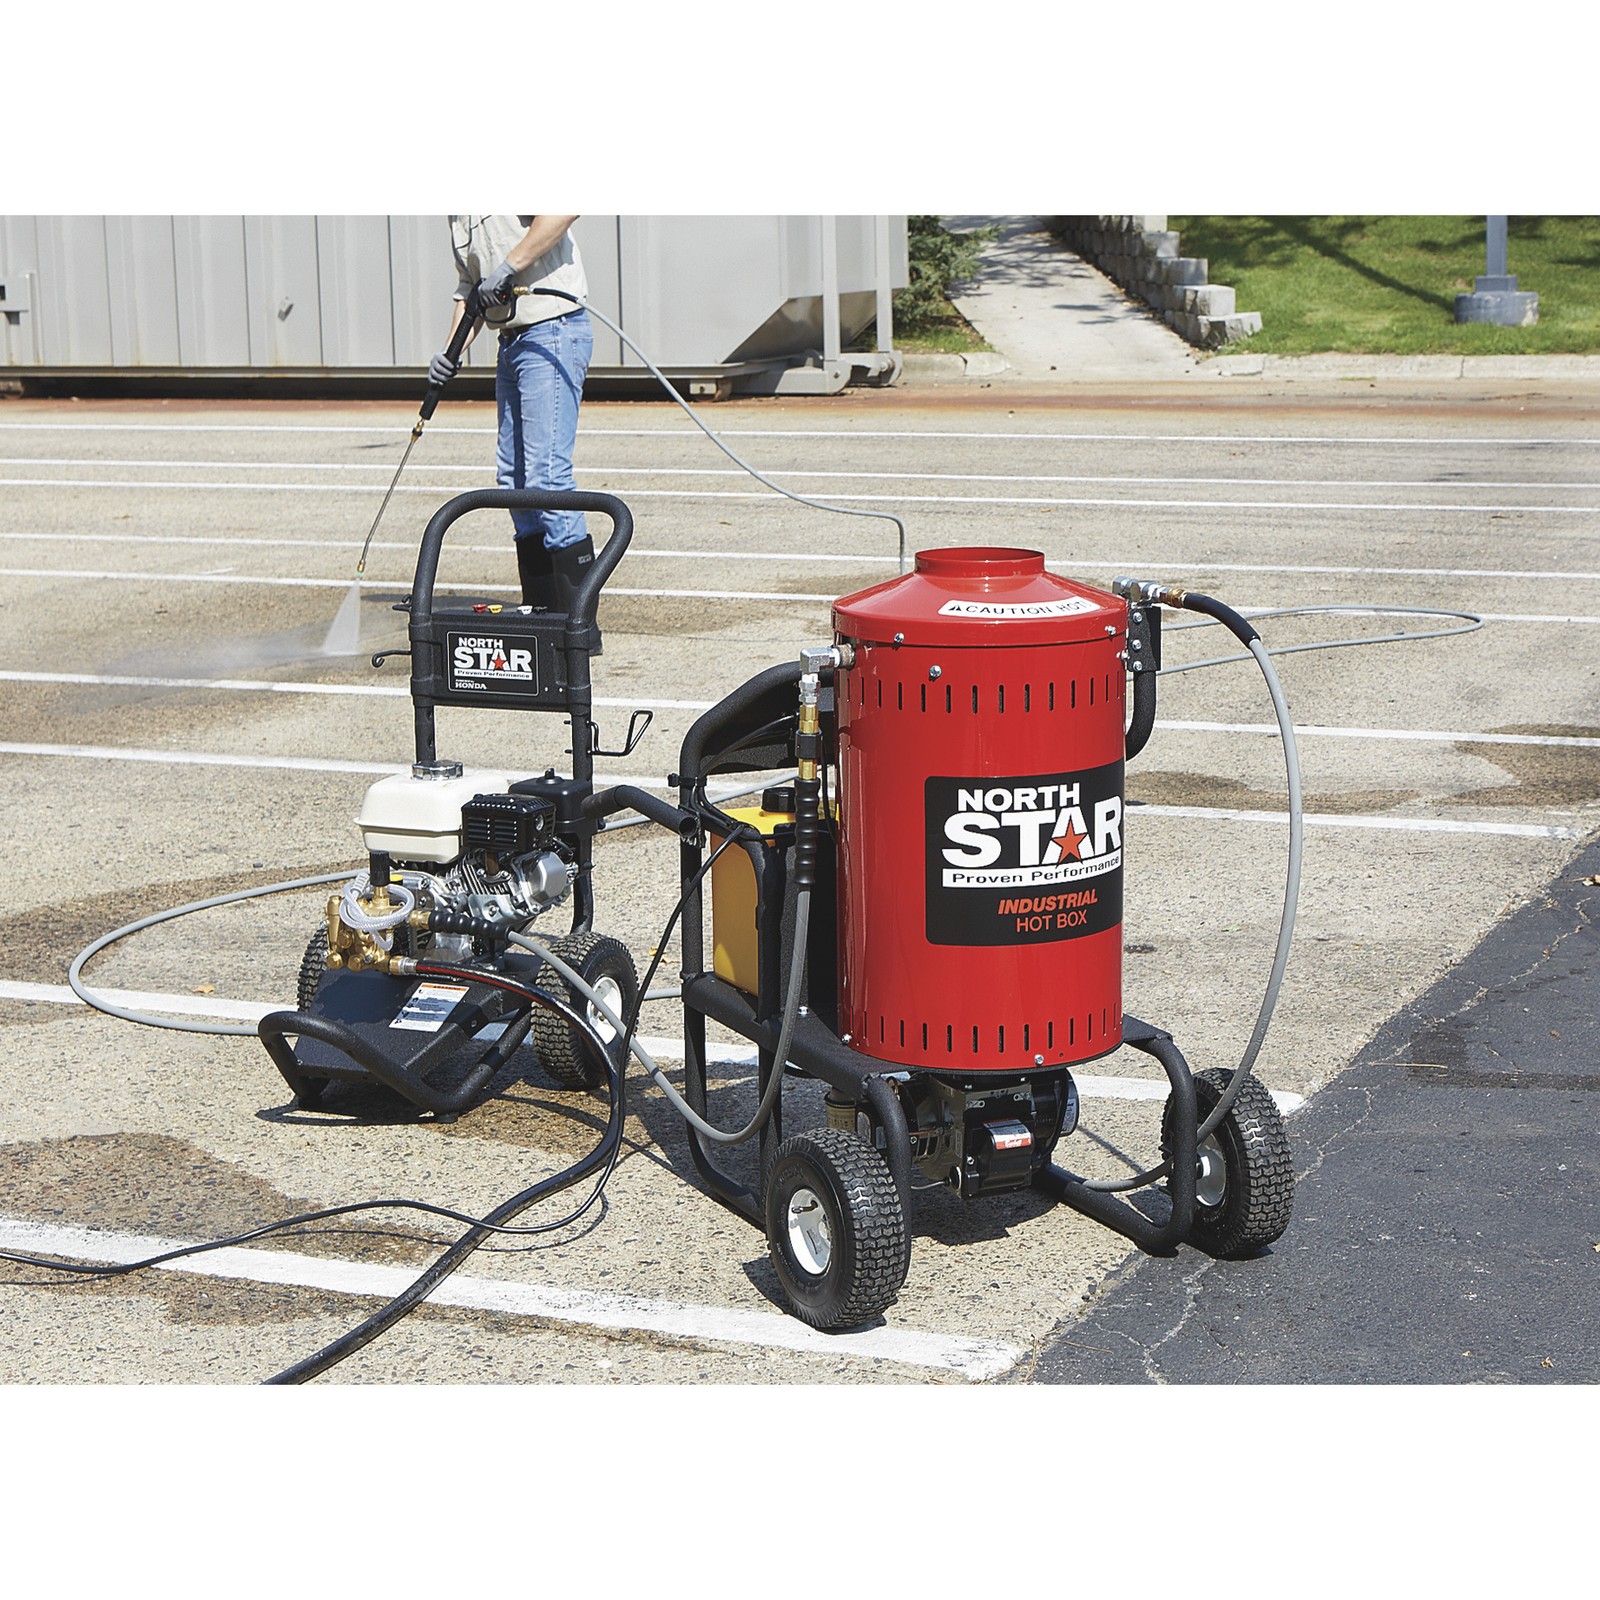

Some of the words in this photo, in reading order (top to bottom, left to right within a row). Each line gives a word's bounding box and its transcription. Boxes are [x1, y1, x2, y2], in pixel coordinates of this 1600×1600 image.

[965, 605, 1053, 615] CAUTION
[458, 637, 503, 648] NORTH
[454, 646, 532, 672] STAR
[957, 782, 1080, 813] NORTH
[941, 795, 1122, 868] STAR
[952, 873, 1023, 884] Proven
[1031, 855, 1119, 882] Performance
[998, 888, 1098, 914] INDUSTRIAL
[1016, 914, 1052, 933] HOT
[1057, 909, 1087, 929] BOX
